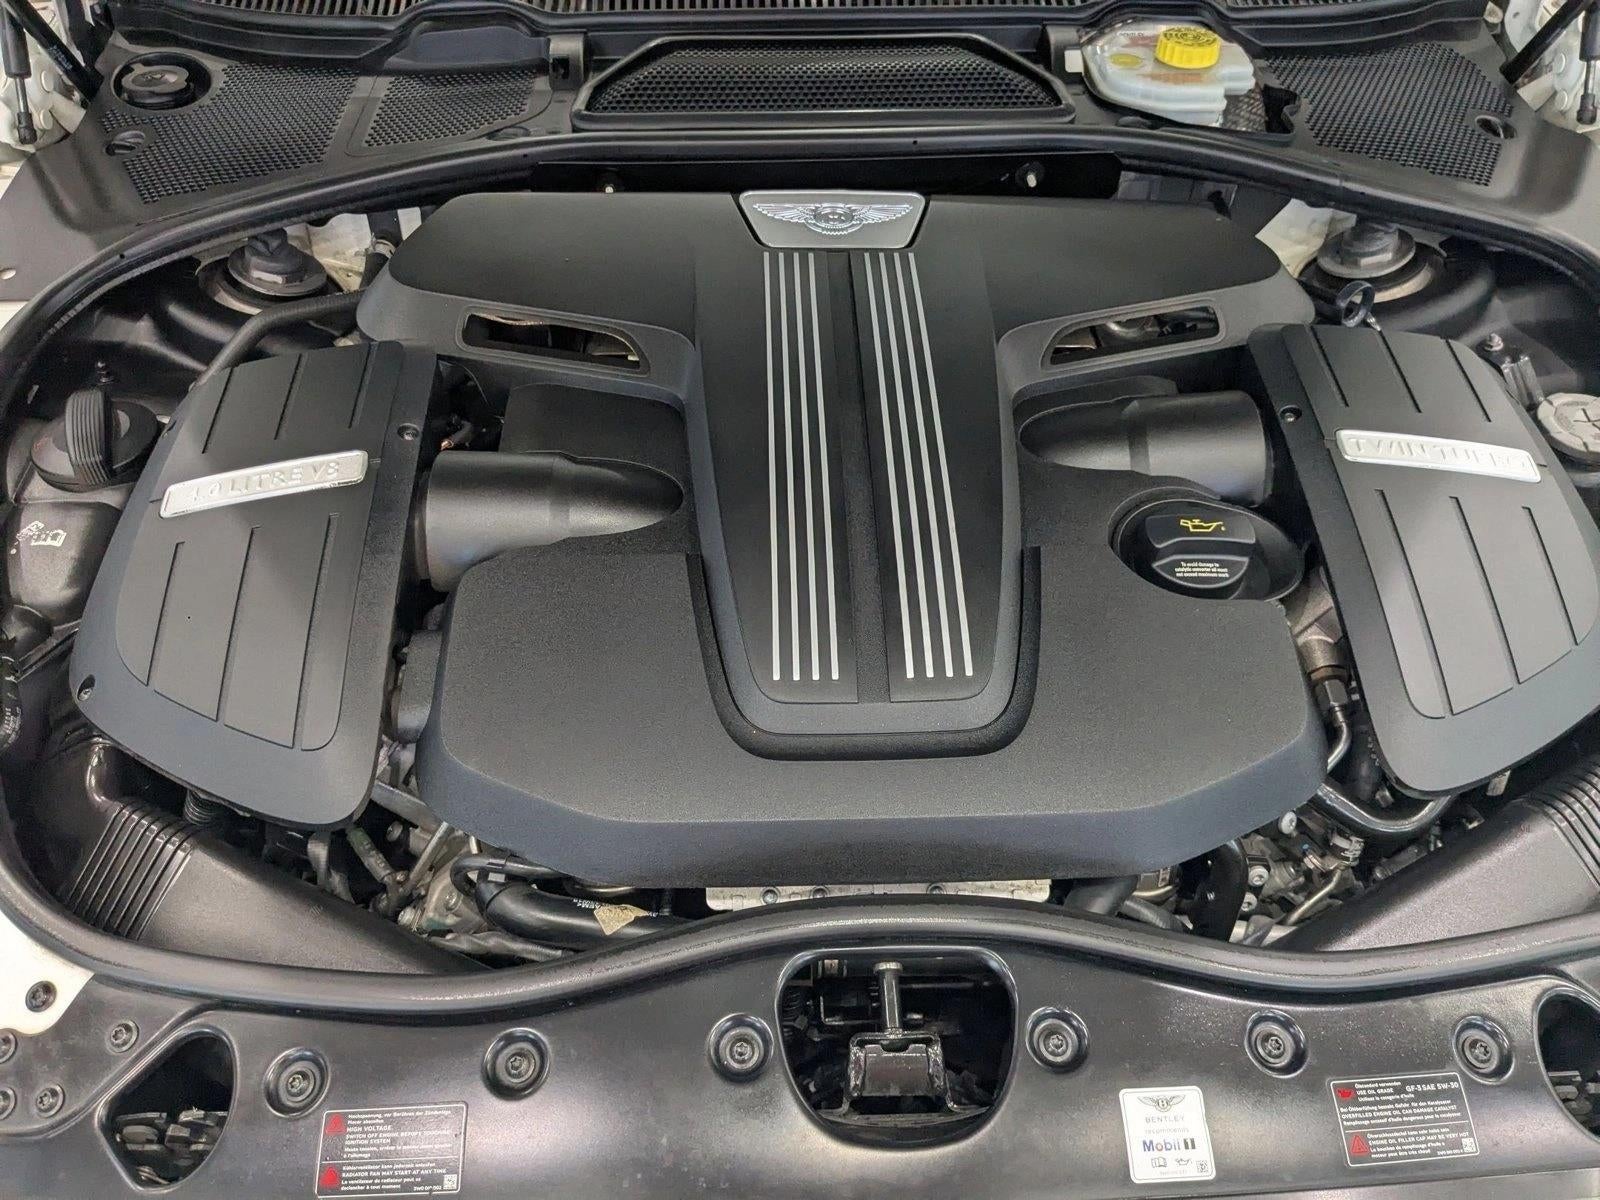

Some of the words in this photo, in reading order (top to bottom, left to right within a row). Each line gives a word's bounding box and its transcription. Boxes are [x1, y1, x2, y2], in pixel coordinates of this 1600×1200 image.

[229, 465, 304, 494] LITRE
[311, 460, 341, 481] V8
[1405, 1084, 1422, 1092] GF-3
[1145, 1114, 1184, 1123] BENTLEY
[1142, 1138, 1180, 1152] Mobil
